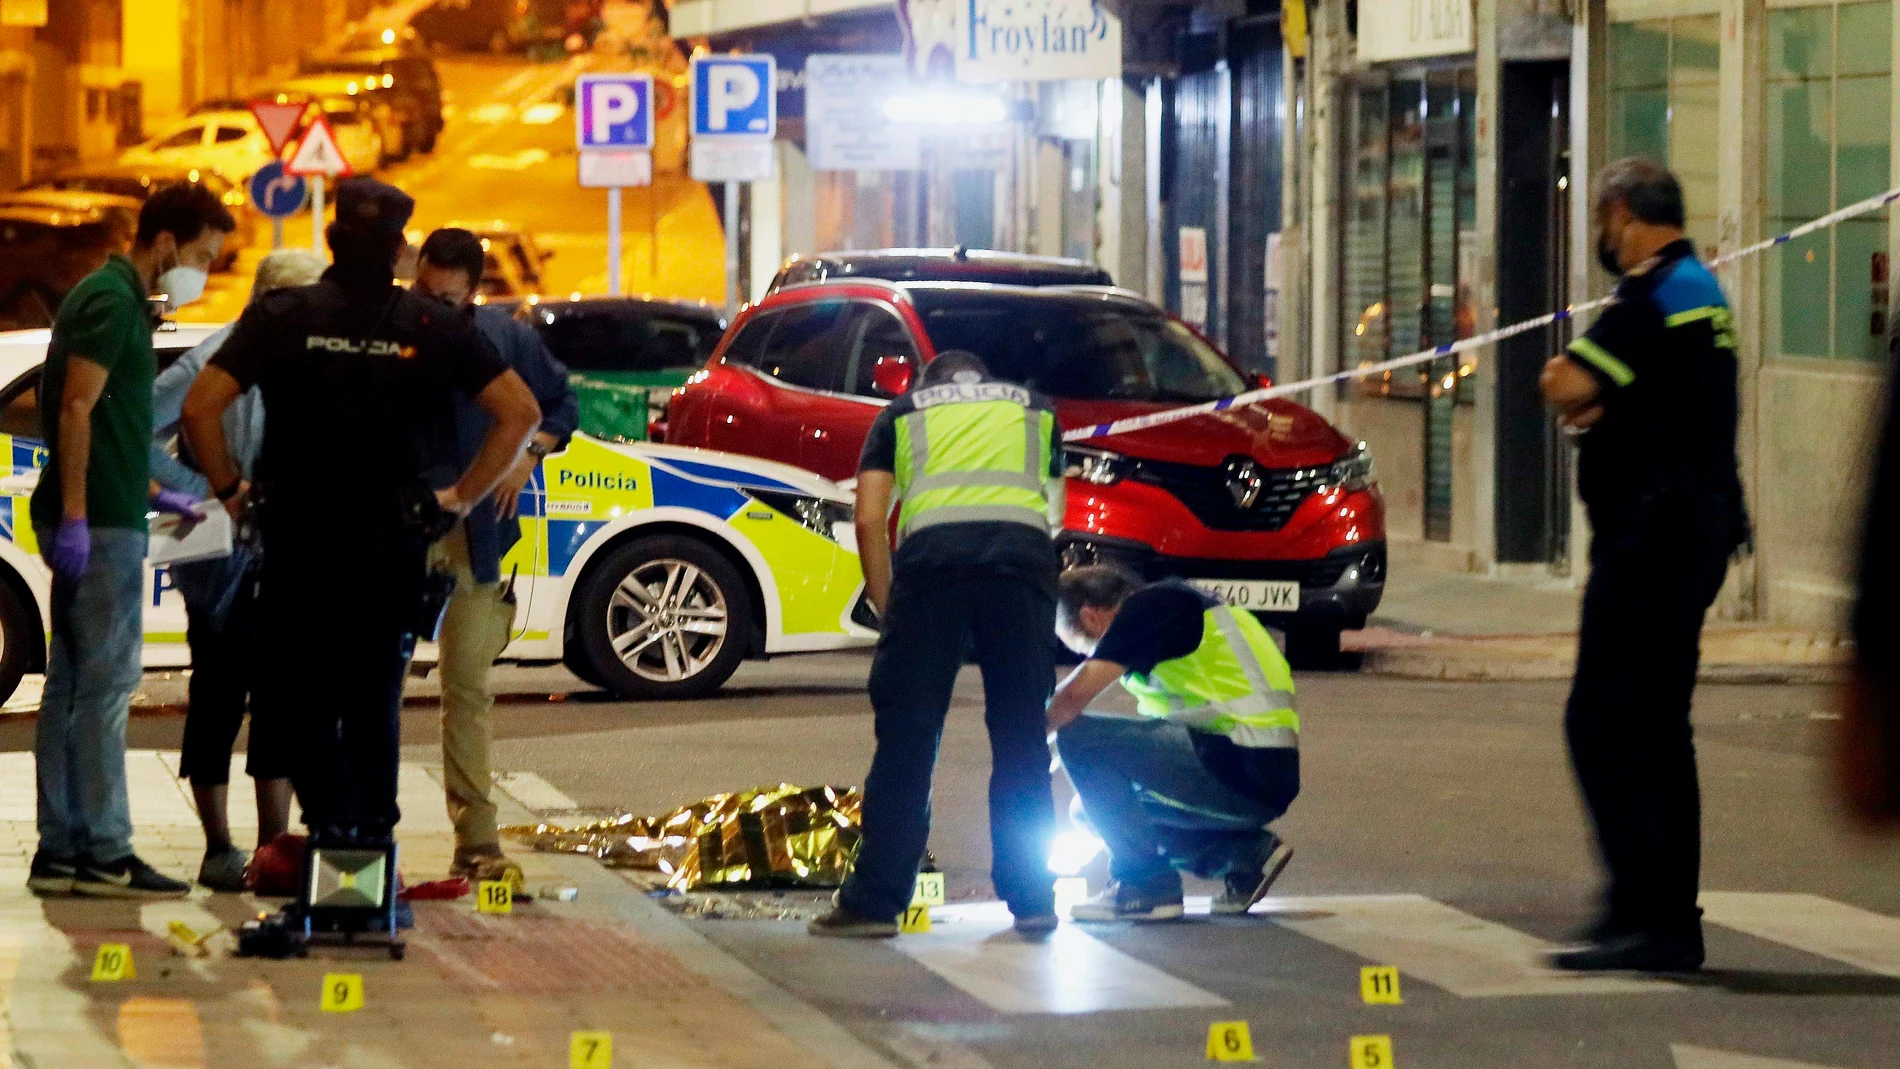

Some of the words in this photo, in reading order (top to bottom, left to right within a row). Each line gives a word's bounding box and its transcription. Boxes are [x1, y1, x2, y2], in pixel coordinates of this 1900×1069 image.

[708, 65, 760, 130] P
[592, 84, 638, 143] P
[560, 469, 637, 490] Policía
[1258, 586, 1292, 606] JVK
[485, 886, 507, 905] 18
[920, 881, 938, 898] 13
[101, 953, 121, 972] 10
[334, 981, 348, 1004] 9
[1370, 974, 1391, 994] 11
[583, 1039, 598, 1061] 7
[1223, 1028, 1240, 1052] 6
[1364, 1044, 1380, 1067] 5
